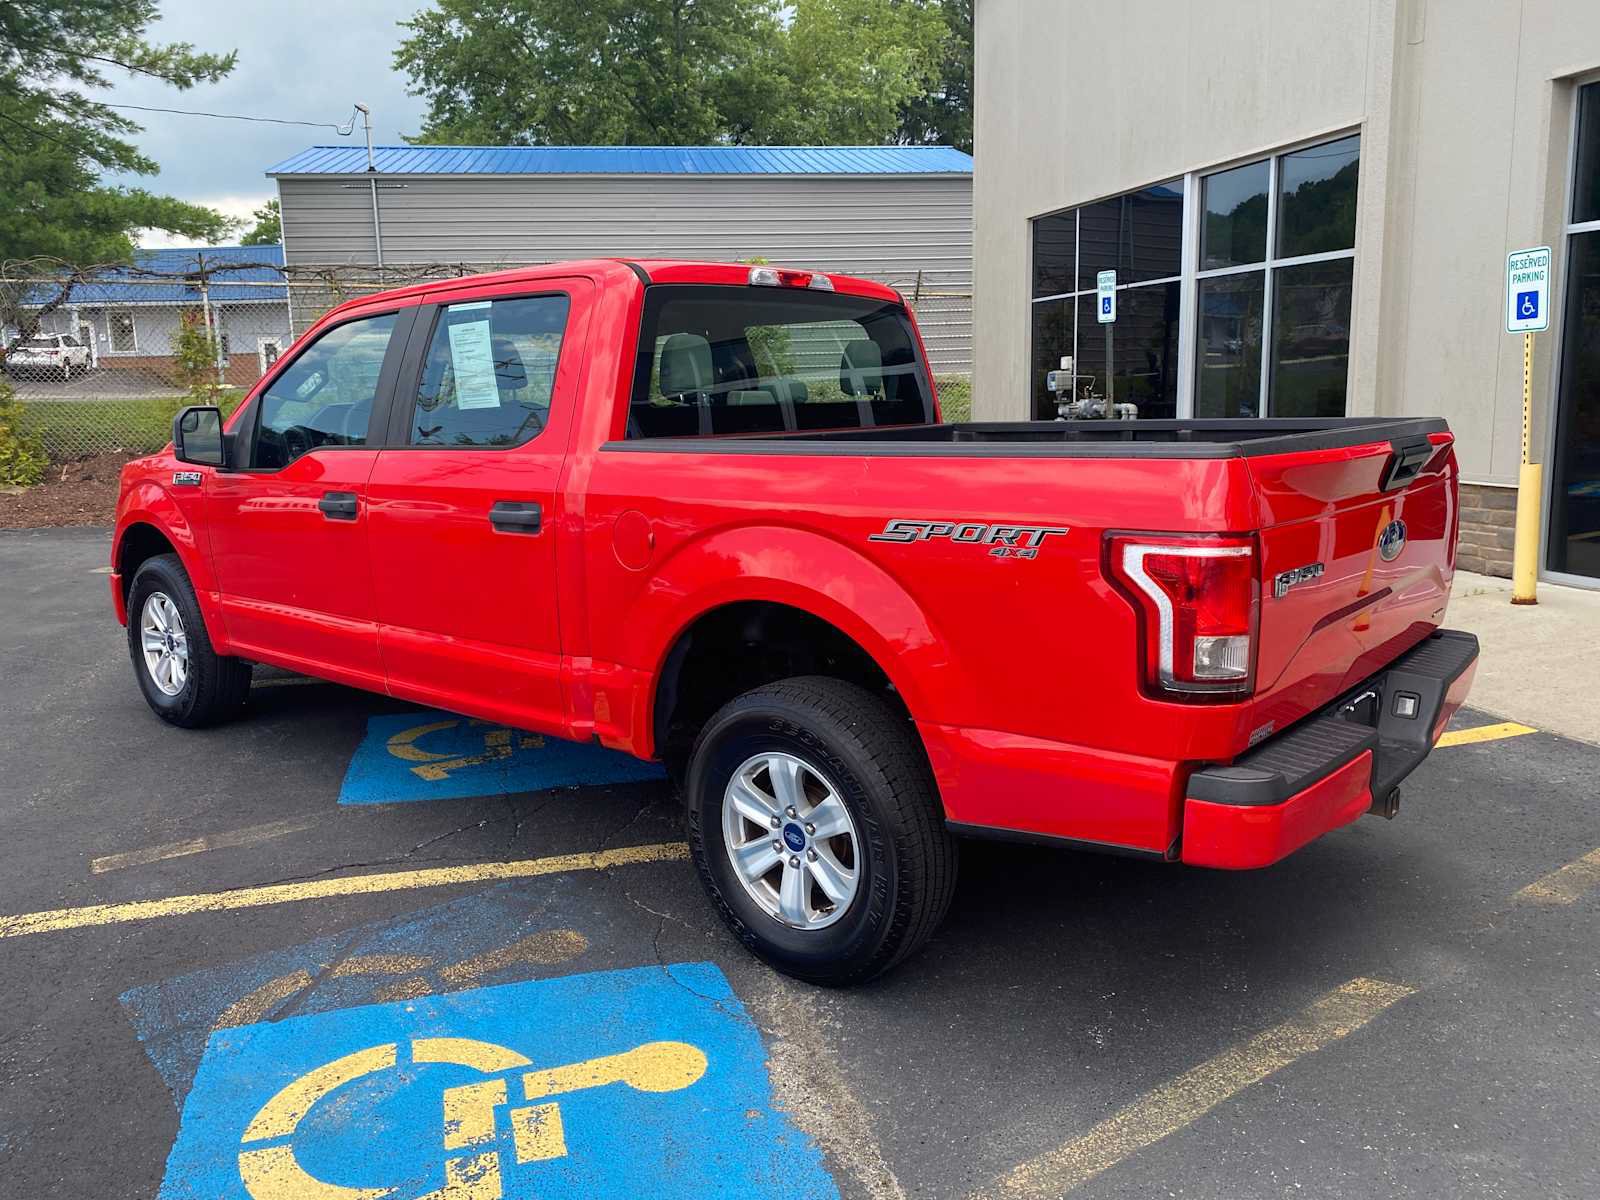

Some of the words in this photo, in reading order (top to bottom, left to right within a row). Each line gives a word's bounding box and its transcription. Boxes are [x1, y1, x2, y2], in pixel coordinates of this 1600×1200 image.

[1510, 256, 1547, 271] RESERVED
[1512, 271, 1544, 284] PARKING
[867, 519, 1070, 547] SPORT
